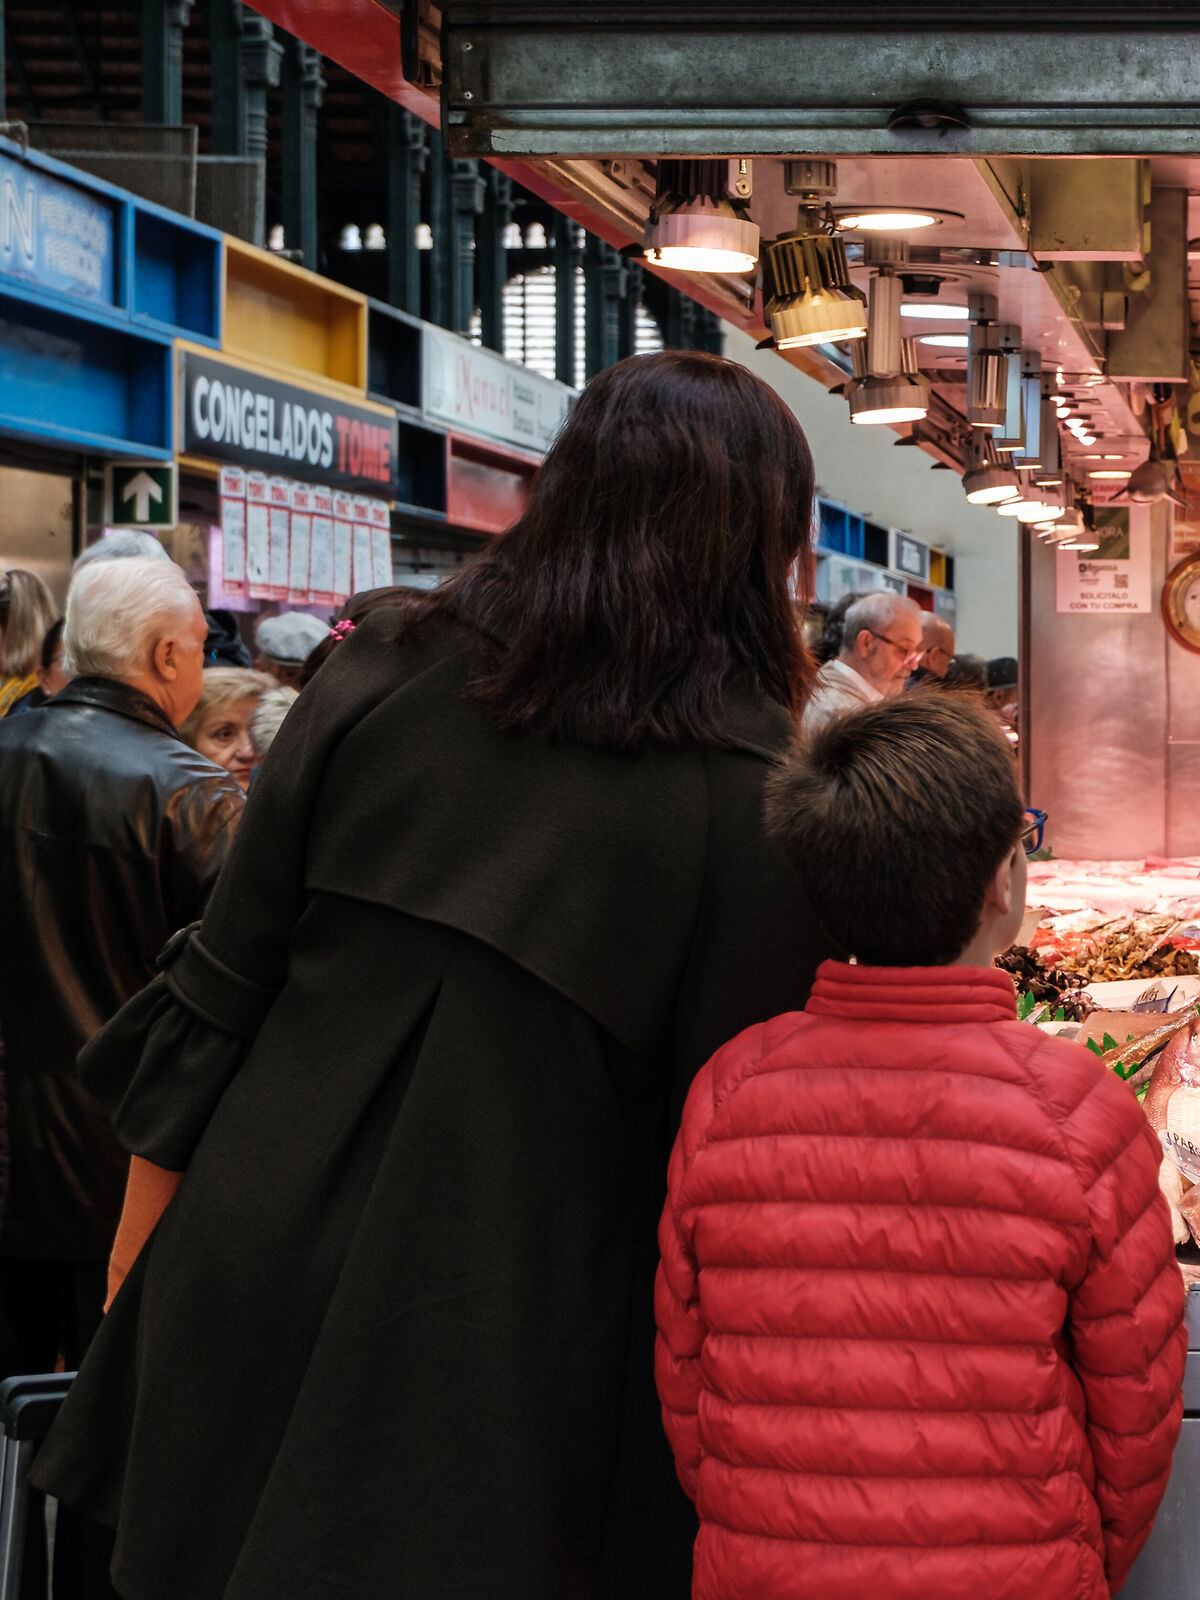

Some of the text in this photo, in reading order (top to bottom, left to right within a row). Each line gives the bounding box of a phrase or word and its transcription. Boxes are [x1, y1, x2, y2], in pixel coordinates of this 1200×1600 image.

[193, 375, 391, 483] CONGELADOS TOME
[1070, 602, 1139, 610] CON TU COMPRA
